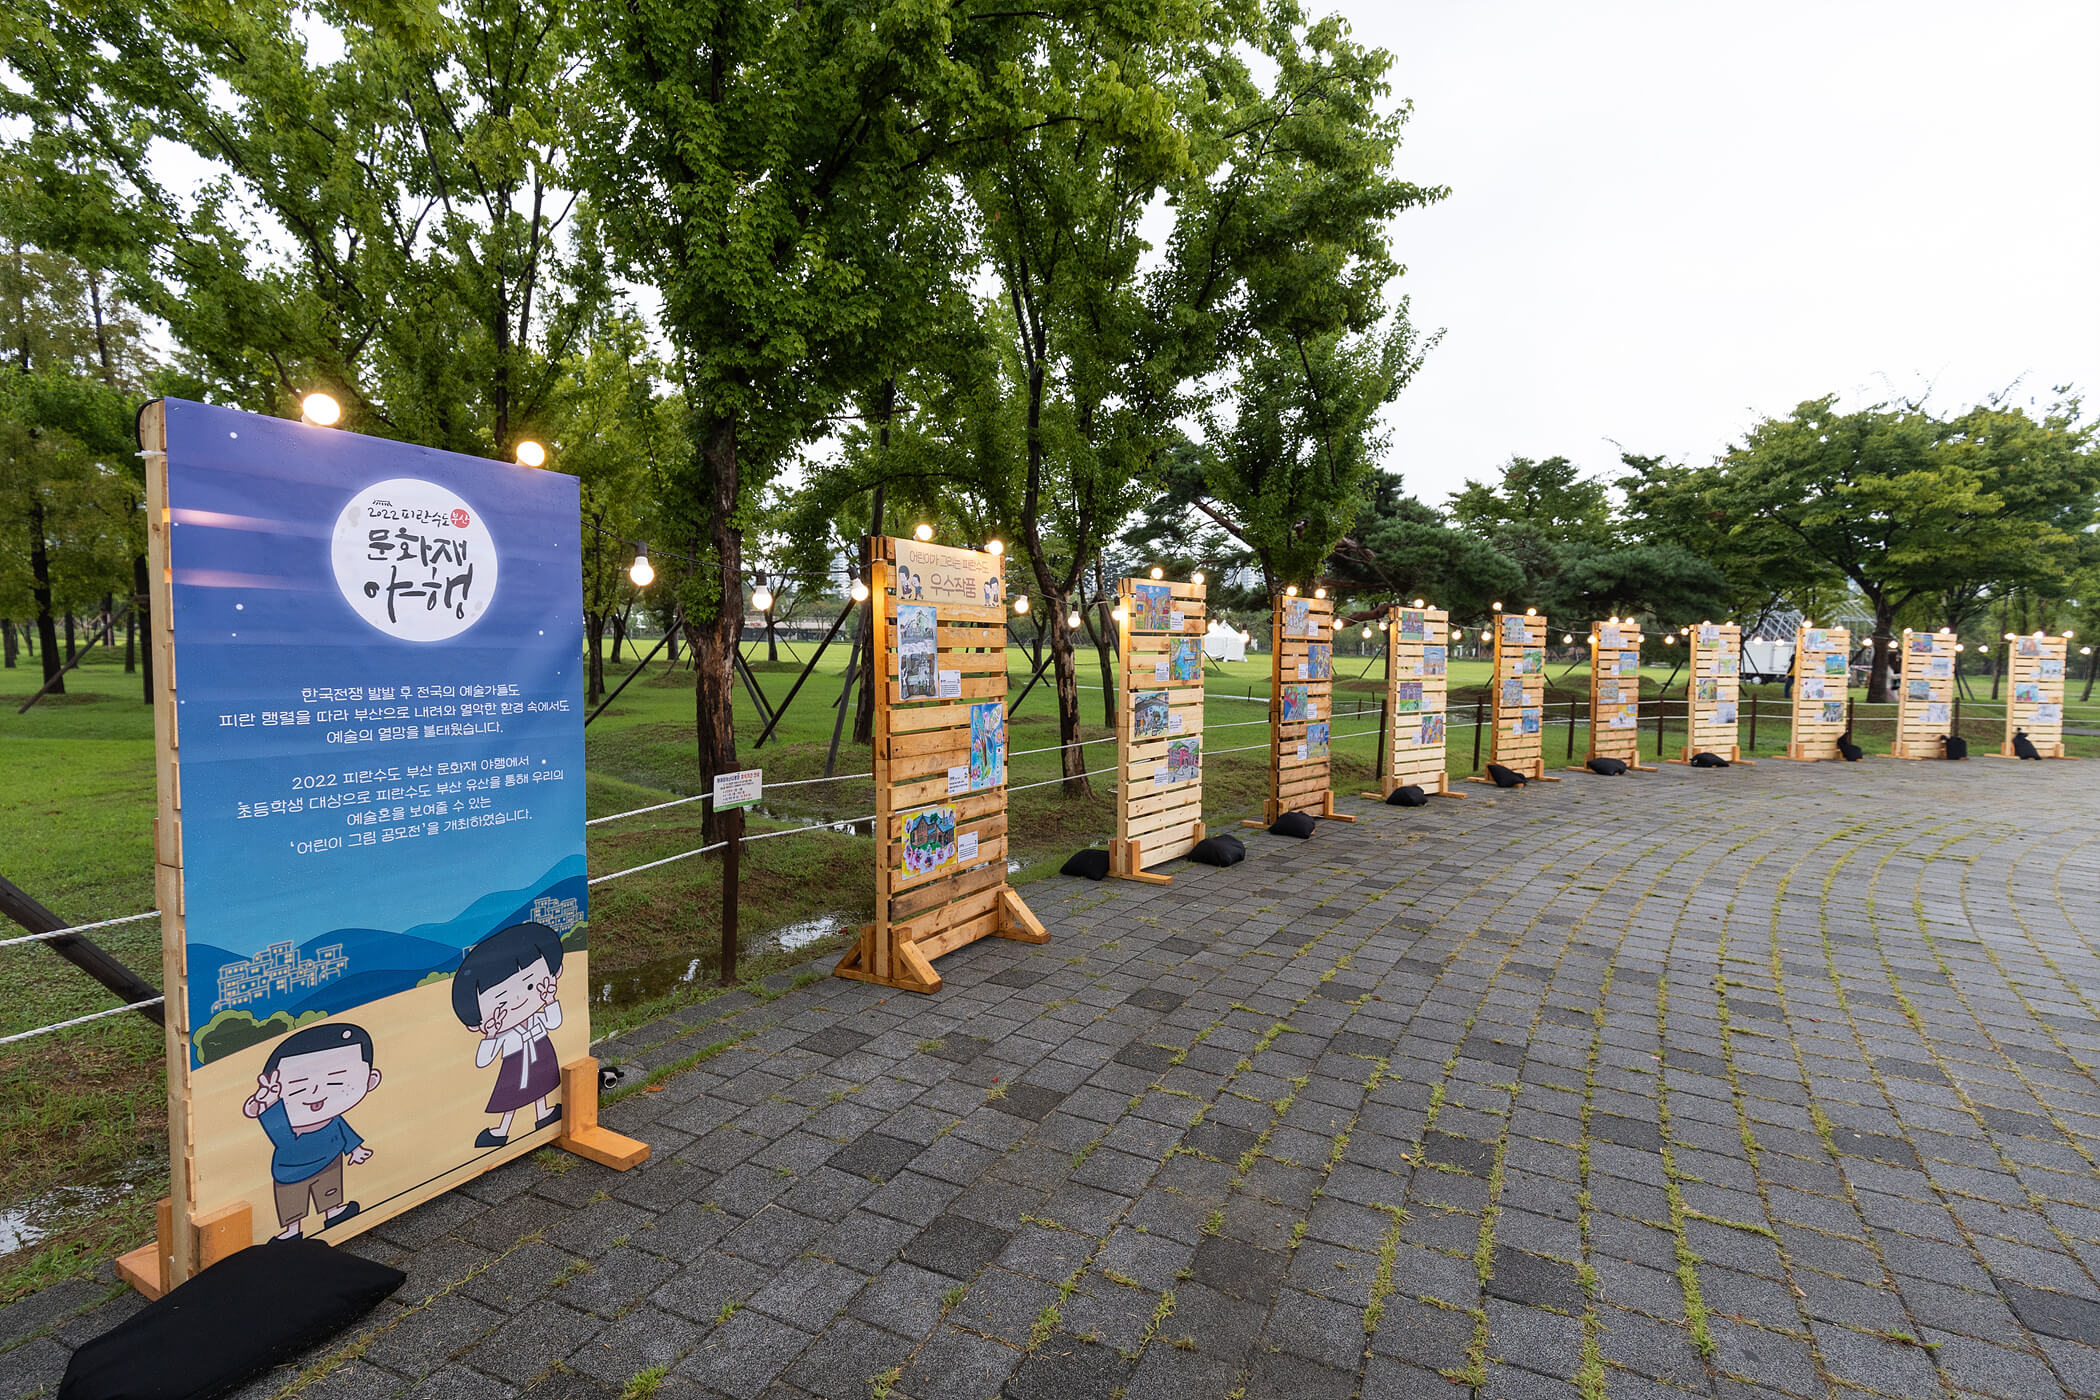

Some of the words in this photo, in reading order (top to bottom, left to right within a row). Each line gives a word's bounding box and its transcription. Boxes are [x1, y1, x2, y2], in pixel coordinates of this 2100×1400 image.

[367, 507, 400, 521] 2022
[401, 509, 449, 528] 피란수도
[451, 510, 470, 527] 부산
[367, 527, 467, 567] 문화재
[909, 550, 939, 566] 어린이가
[364, 563, 473, 624] 야행
[930, 573, 976, 599] 우수작품
[300, 686, 363, 703] 한국전쟁
[368, 686, 396, 701] 발발
[400, 685, 413, 700] 후
[417, 684, 456, 699] 전국의
[459, 683, 521, 698] 예술가들도
[219, 713, 256, 728] 피란
[261, 709, 312, 727] 행렬을
[316, 709, 349, 723] 따라
[354, 706, 411, 722] 부산으로
[414, 704, 457, 718] 내려와
[460, 702, 497, 716] 열악한
[500, 701, 524, 715] 환경
[527, 699, 570, 713] 속에서도
[326, 728, 374, 745] 예술의
[377, 725, 419, 741] 열망을
[423, 721, 504, 738] 불태웠습니다.
[291, 773, 339, 790] 2022
[343, 767, 402, 784] 피란수도
[406, 764, 433, 779] 부산
[437, 760, 477, 775] 문화재
[480, 755, 529, 770] 야행에서
[236, 797, 304, 820] 초등학생
[309, 790, 372, 809] 대상으로
[375, 783, 433, 801] 피란수도
[436, 780, 462, 795] 부산
[466, 775, 501, 791] 유산을
[504, 773, 529, 787] 통해
[532, 769, 564, 784] 우리의
[346, 806, 405, 826] 예술혼을
[409, 801, 449, 818] 보여줄
[452, 799, 465, 812] 수
[468, 796, 492, 810] 있는
[347, 831, 376, 848] 그림
[443, 808, 533, 832] 개최하였습니다.
